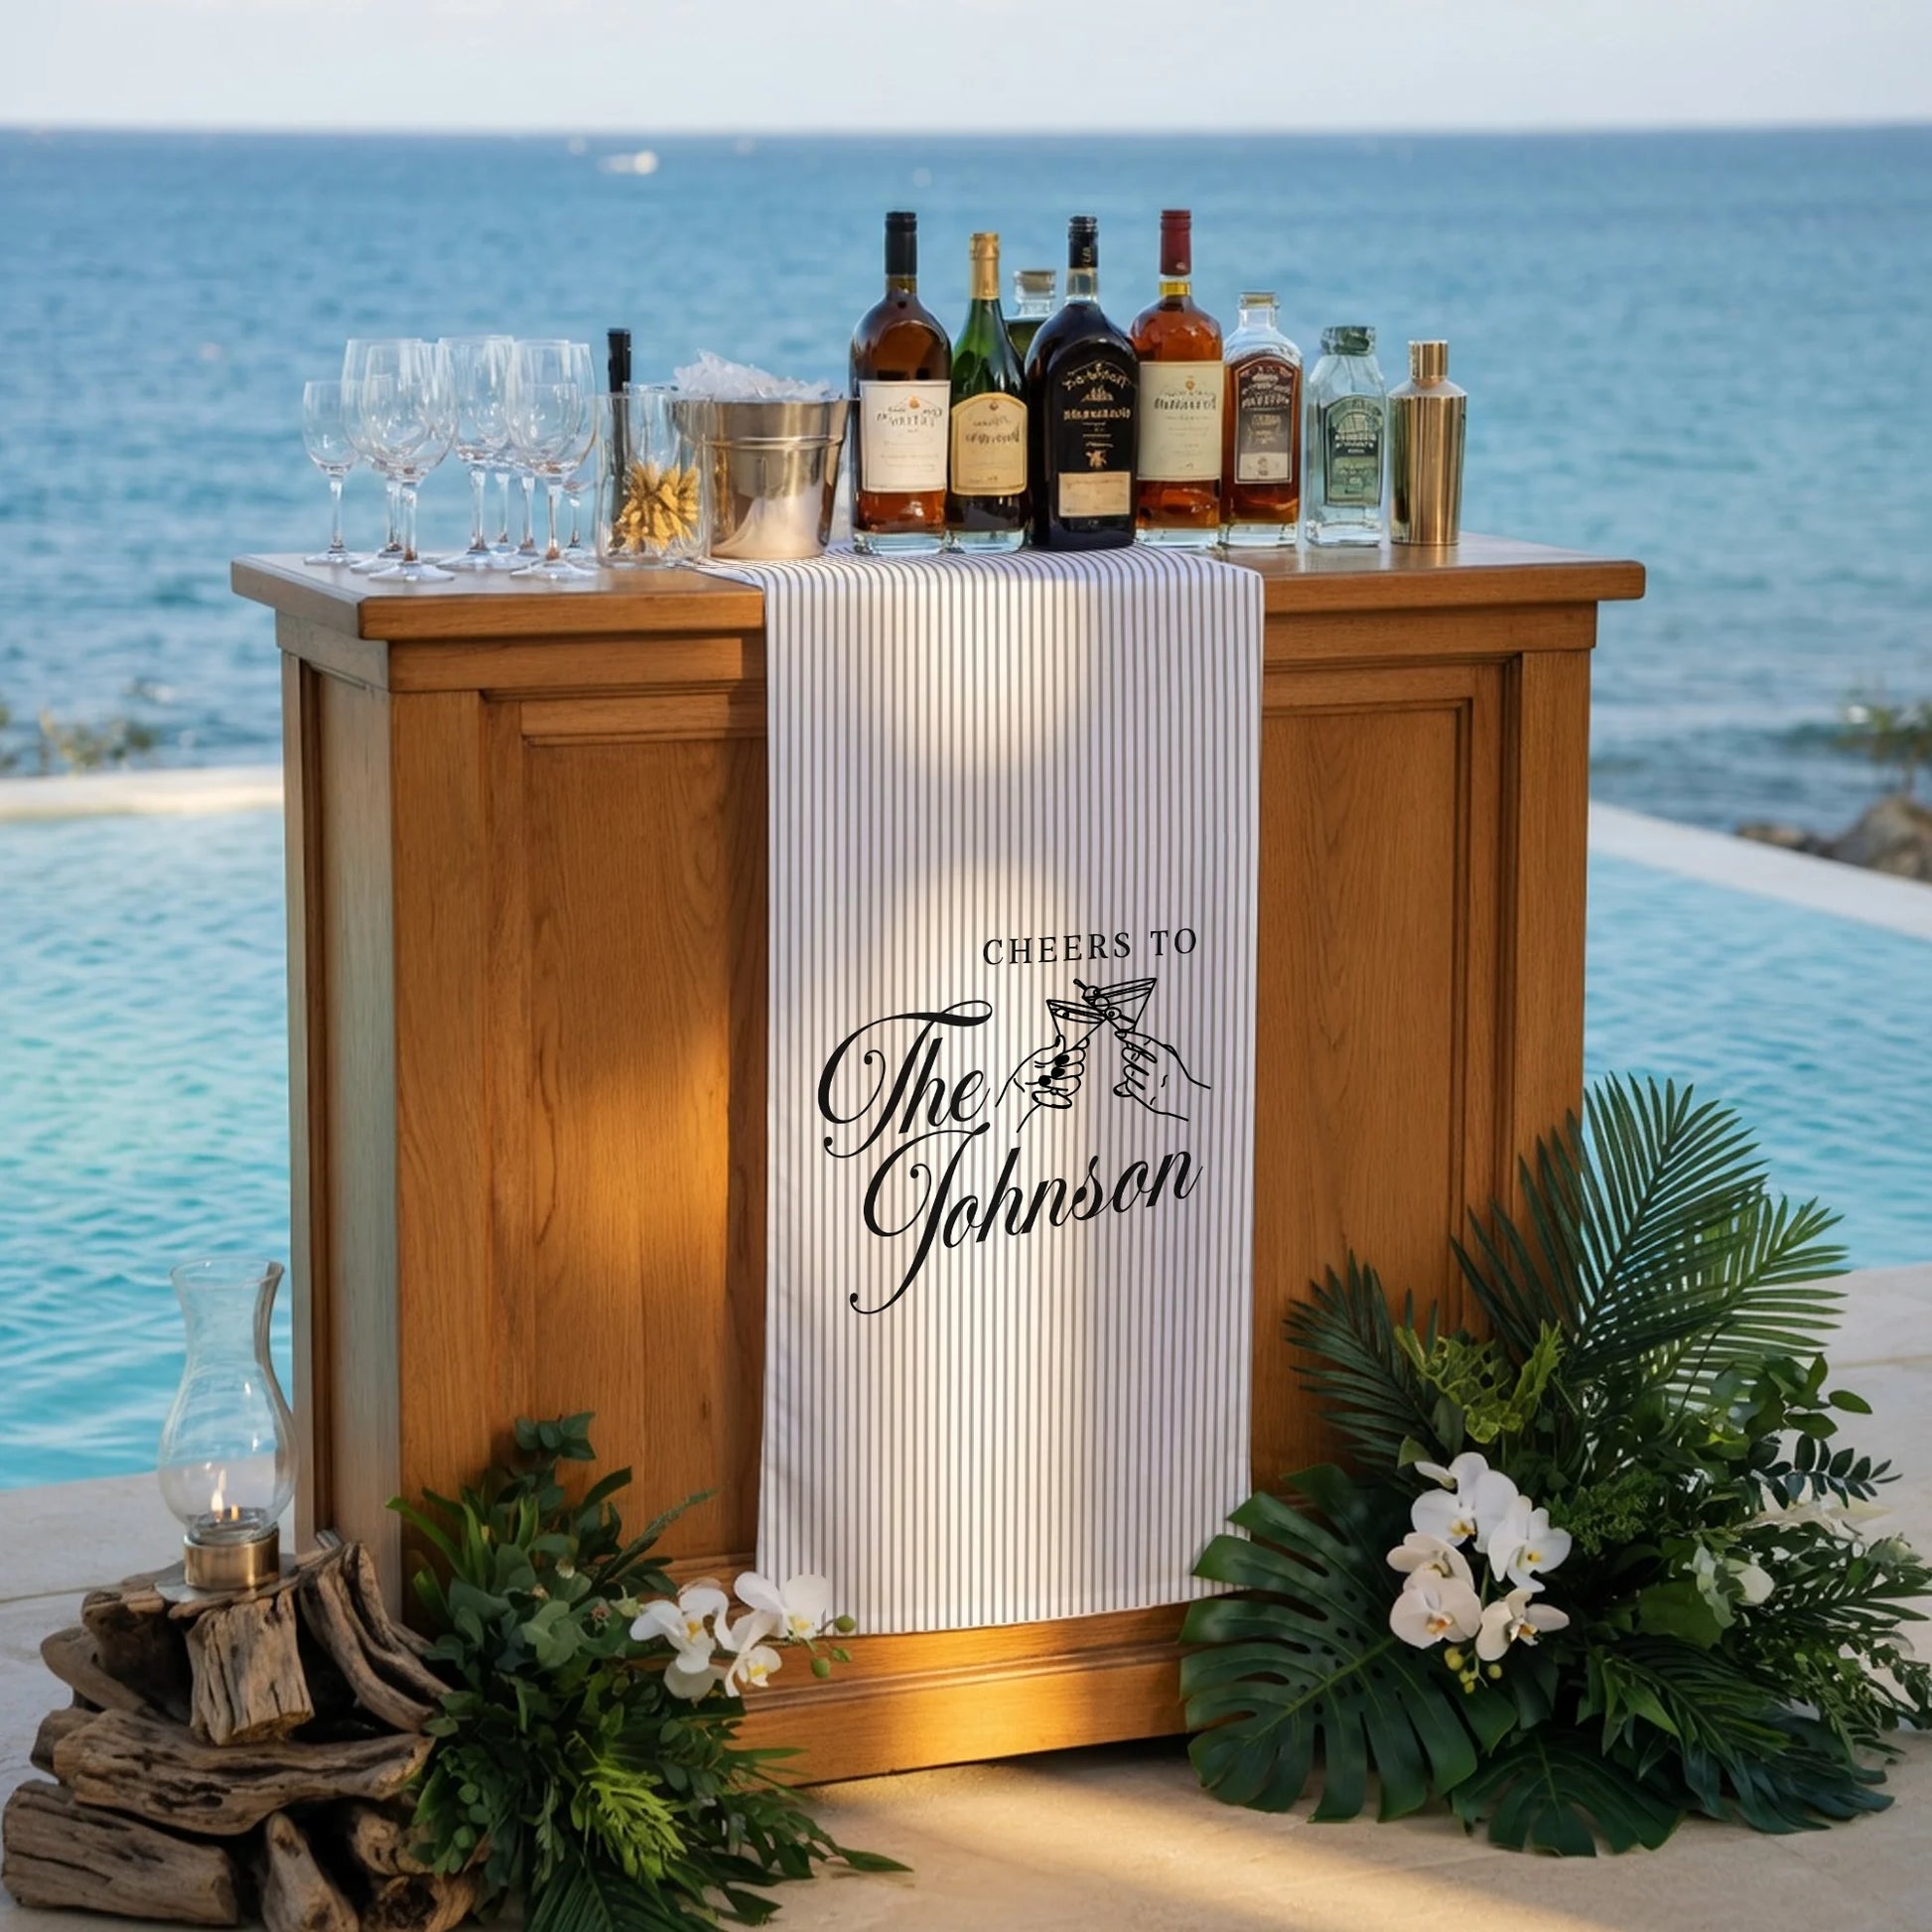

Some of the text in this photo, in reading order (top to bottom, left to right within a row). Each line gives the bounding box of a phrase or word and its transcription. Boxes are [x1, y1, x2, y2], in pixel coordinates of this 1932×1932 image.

[982, 927, 1197, 965] CHEERS TO
[817, 999, 993, 1159] The
[849, 1121, 1203, 1314] Johnson
